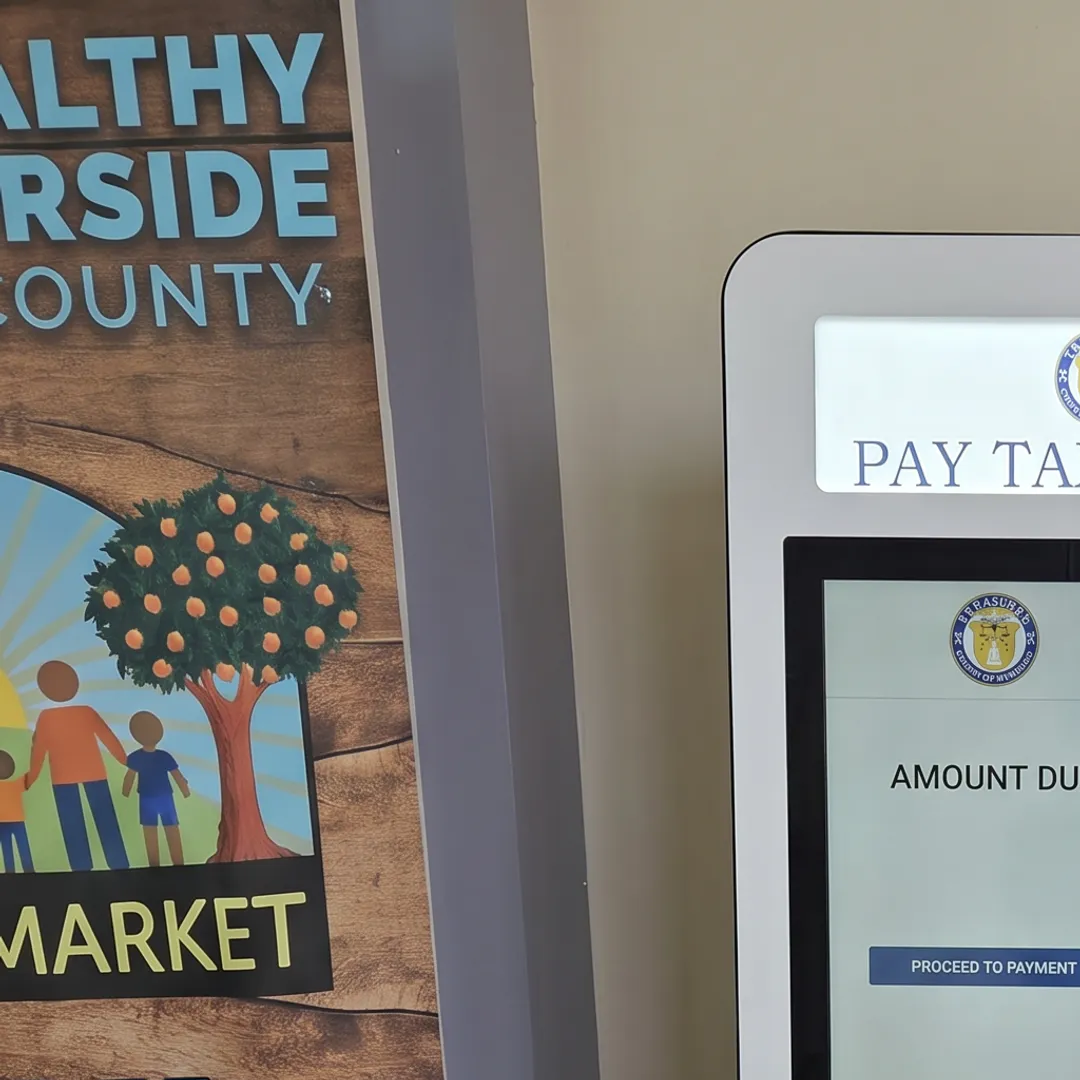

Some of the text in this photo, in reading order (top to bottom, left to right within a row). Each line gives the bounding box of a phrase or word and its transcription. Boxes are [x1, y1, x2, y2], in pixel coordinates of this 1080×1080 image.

[0, 262, 323, 329] OUNTY
[852, 439, 973, 487] PAY
[890, 764, 1029, 790] AMOUNT
[911, 959, 1078, 975] PROCEED TO PAYMENT
